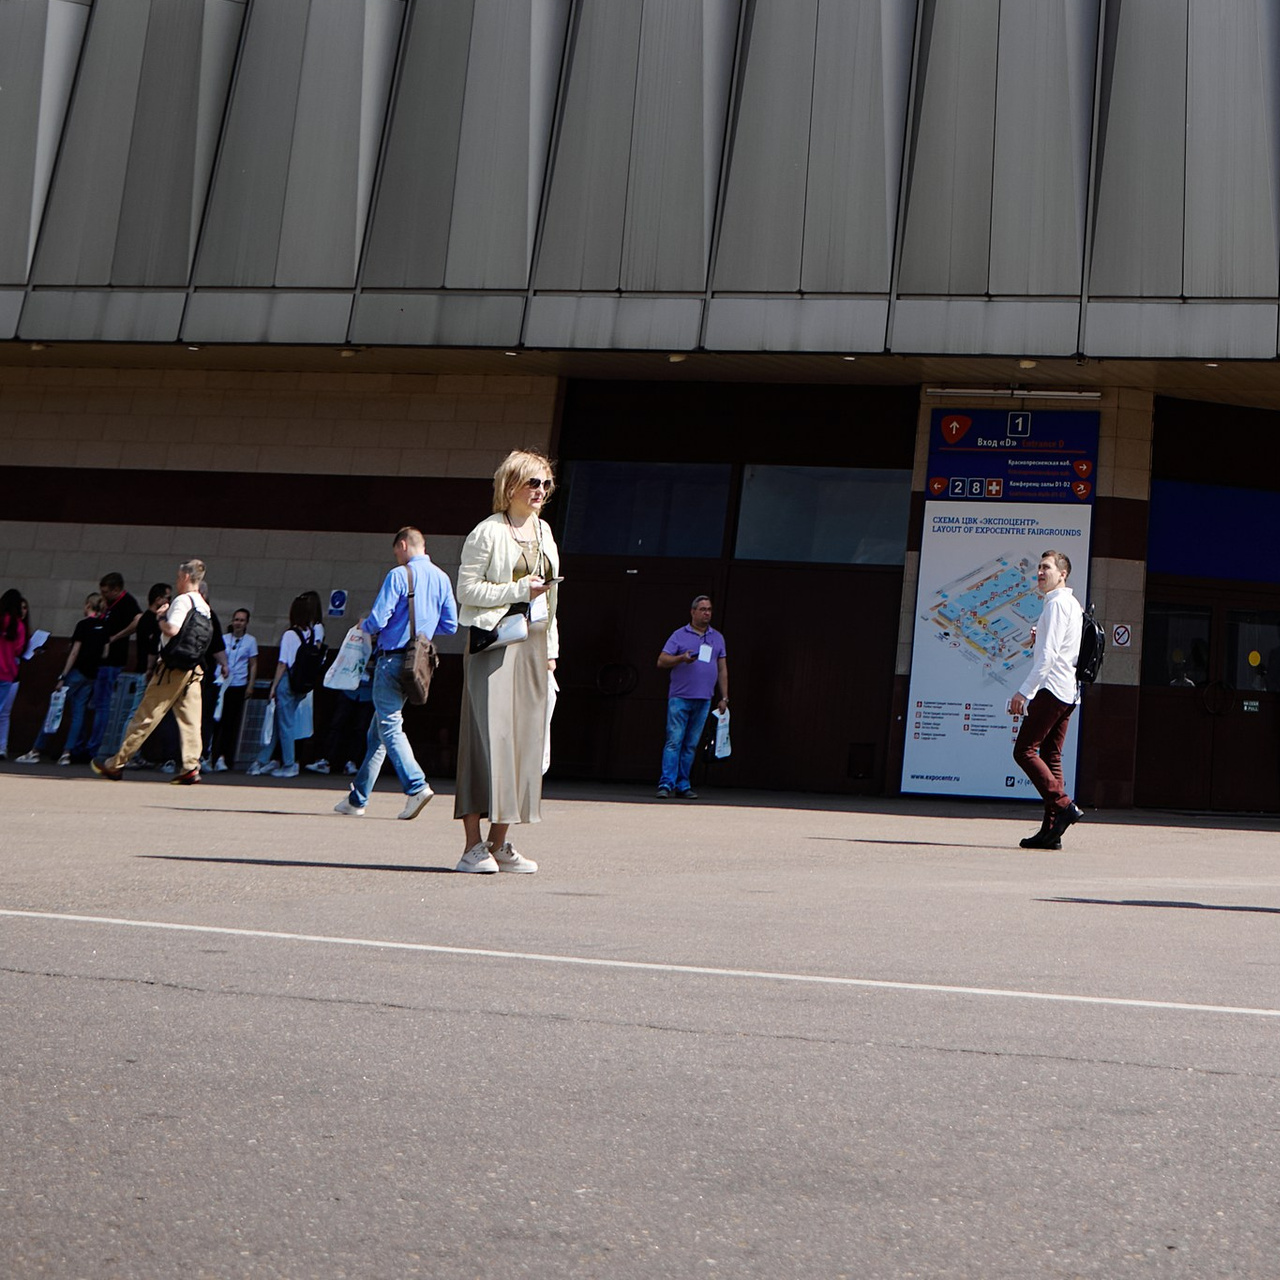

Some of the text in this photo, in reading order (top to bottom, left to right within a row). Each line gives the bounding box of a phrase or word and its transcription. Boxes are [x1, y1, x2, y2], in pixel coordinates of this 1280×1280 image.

[1015, 417, 1023, 432] 1
[977, 437, 1017, 447] Вход «D»
[954, 481, 981, 494] 2 8
[932, 516, 960, 524] СХЕМА
[962, 517, 978, 526] ЦВК
[963, 526, 974, 534] OF
[975, 527, 1026, 535] EXPOCENTRE
[1027, 528, 1082, 537] FAIRGROUNDS
